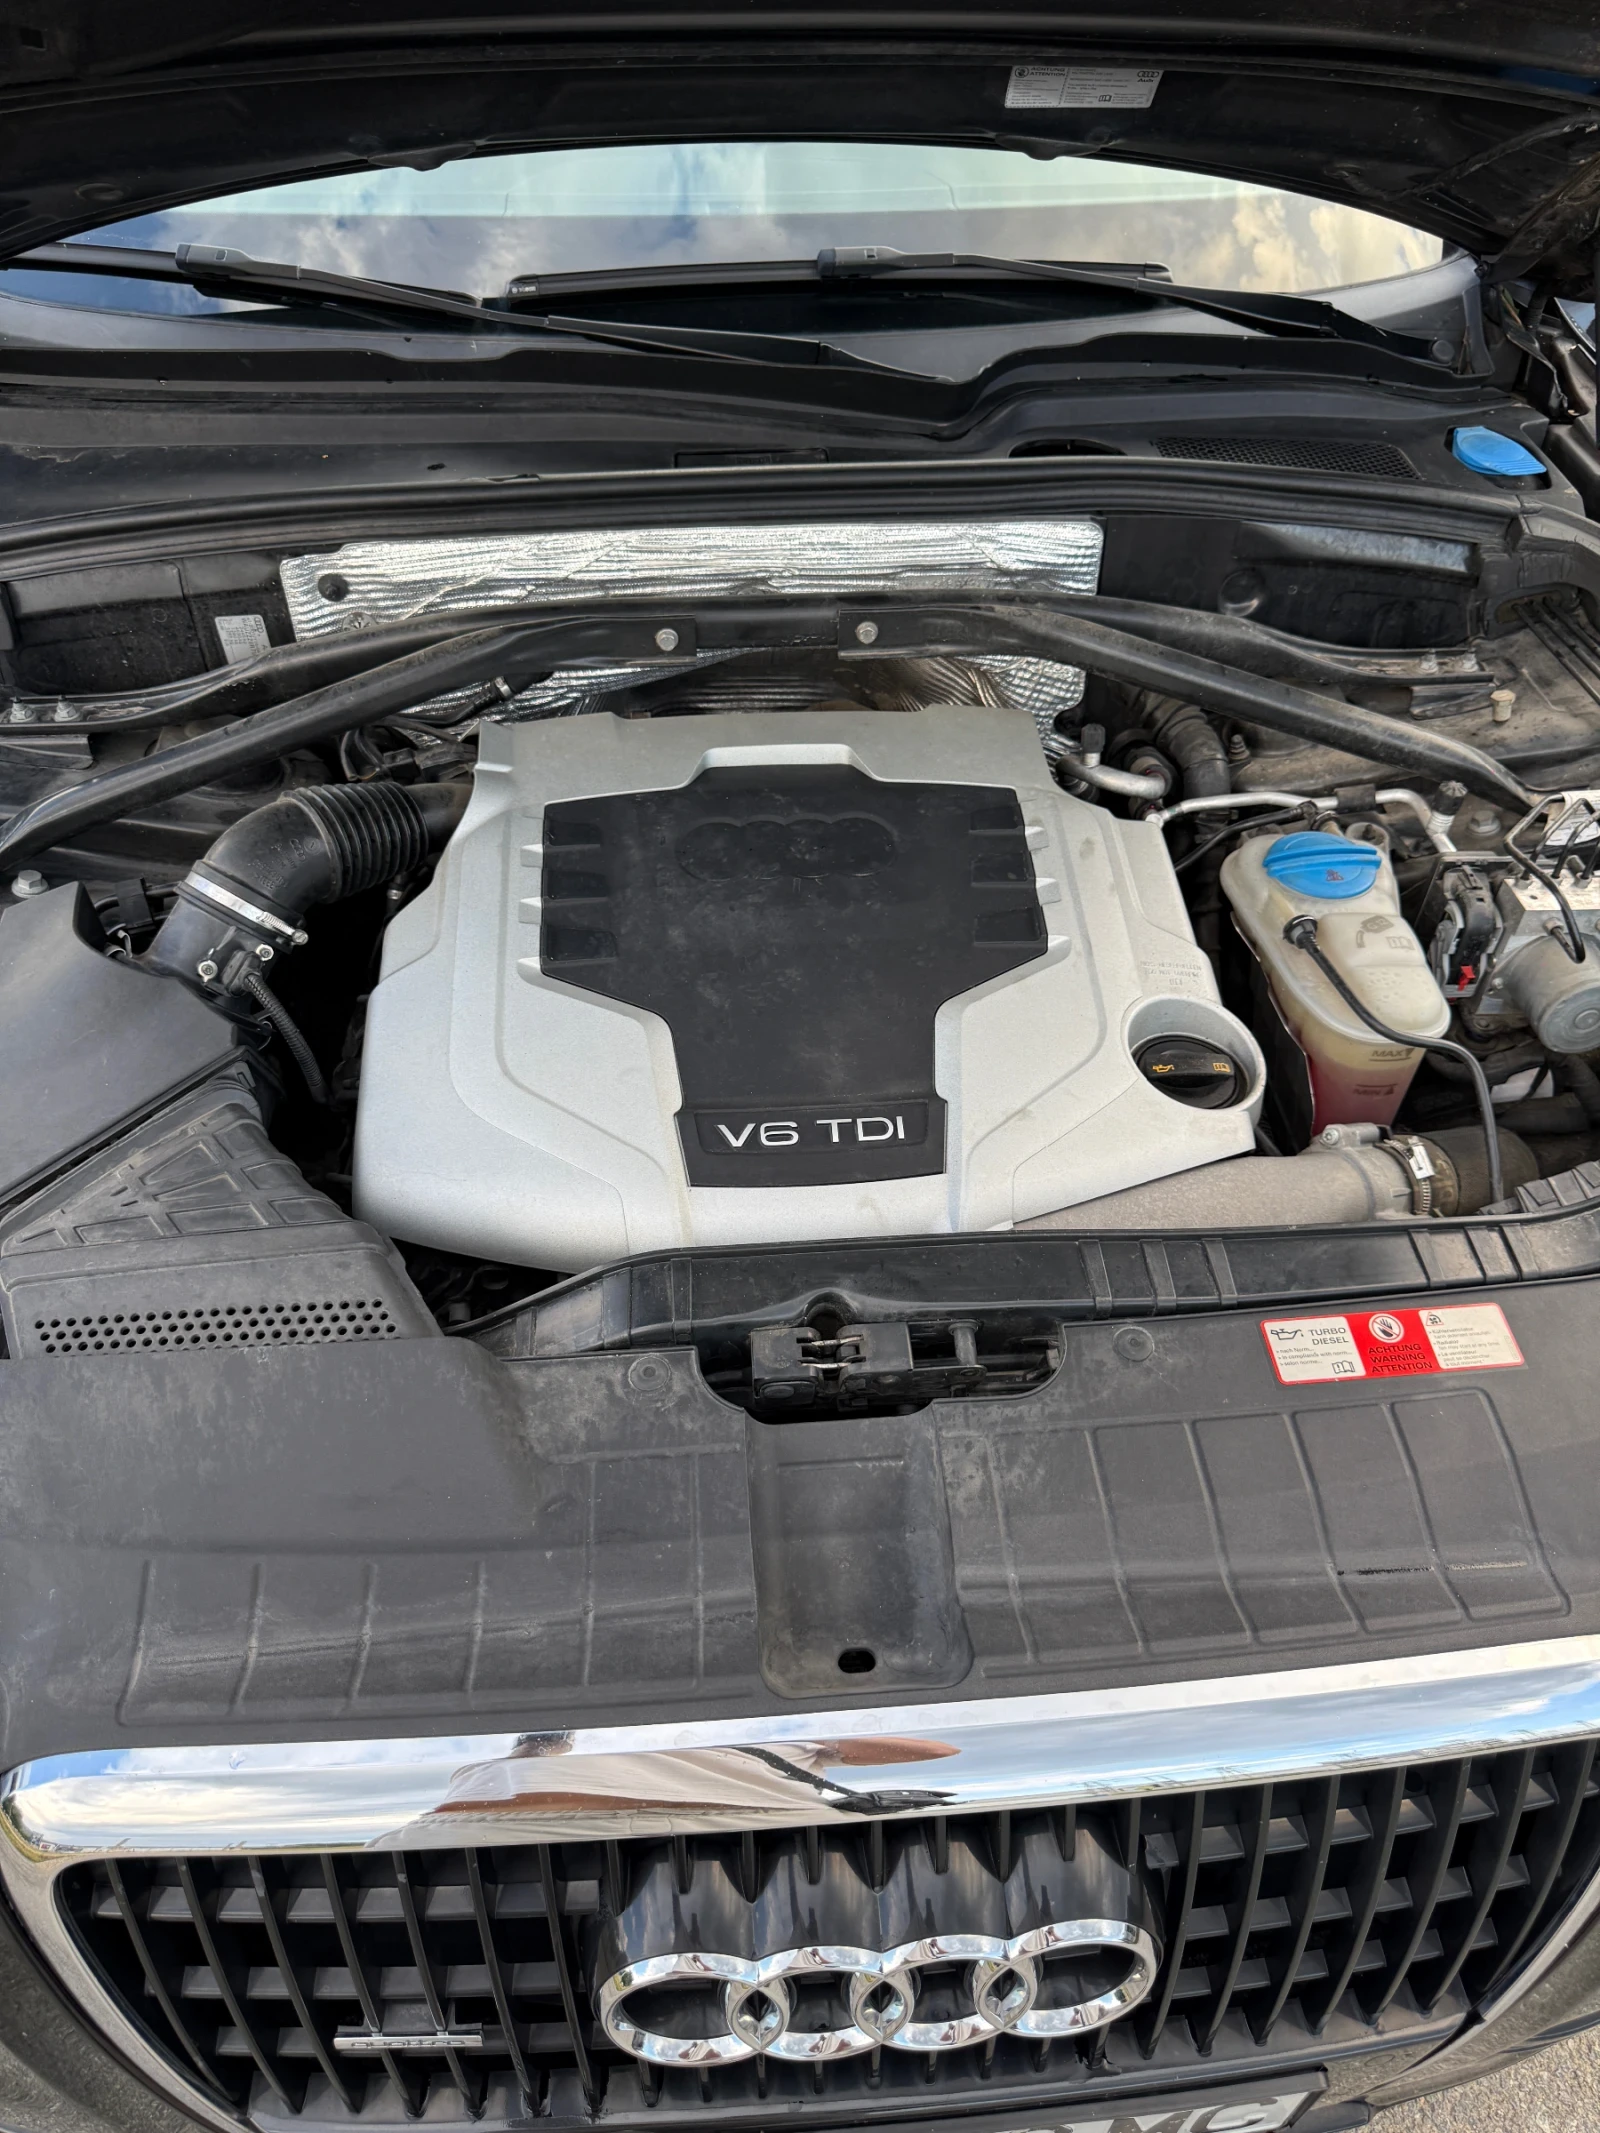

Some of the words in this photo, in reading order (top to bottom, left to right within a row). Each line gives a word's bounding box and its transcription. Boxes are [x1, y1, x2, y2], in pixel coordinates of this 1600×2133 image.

[1371, 1049, 1406, 1058] MAX
[717, 1121, 799, 1148] V6
[816, 1115, 906, 1143] TDI
[1308, 1327, 1347, 1336] TURBO
[1312, 1336, 1349, 1345] DIESEL
[1369, 1343, 1422, 1354] ACHTUNG
[1370, 1352, 1426, 1363] WARNING
[1372, 1361, 1433, 1373] ATTENTION
